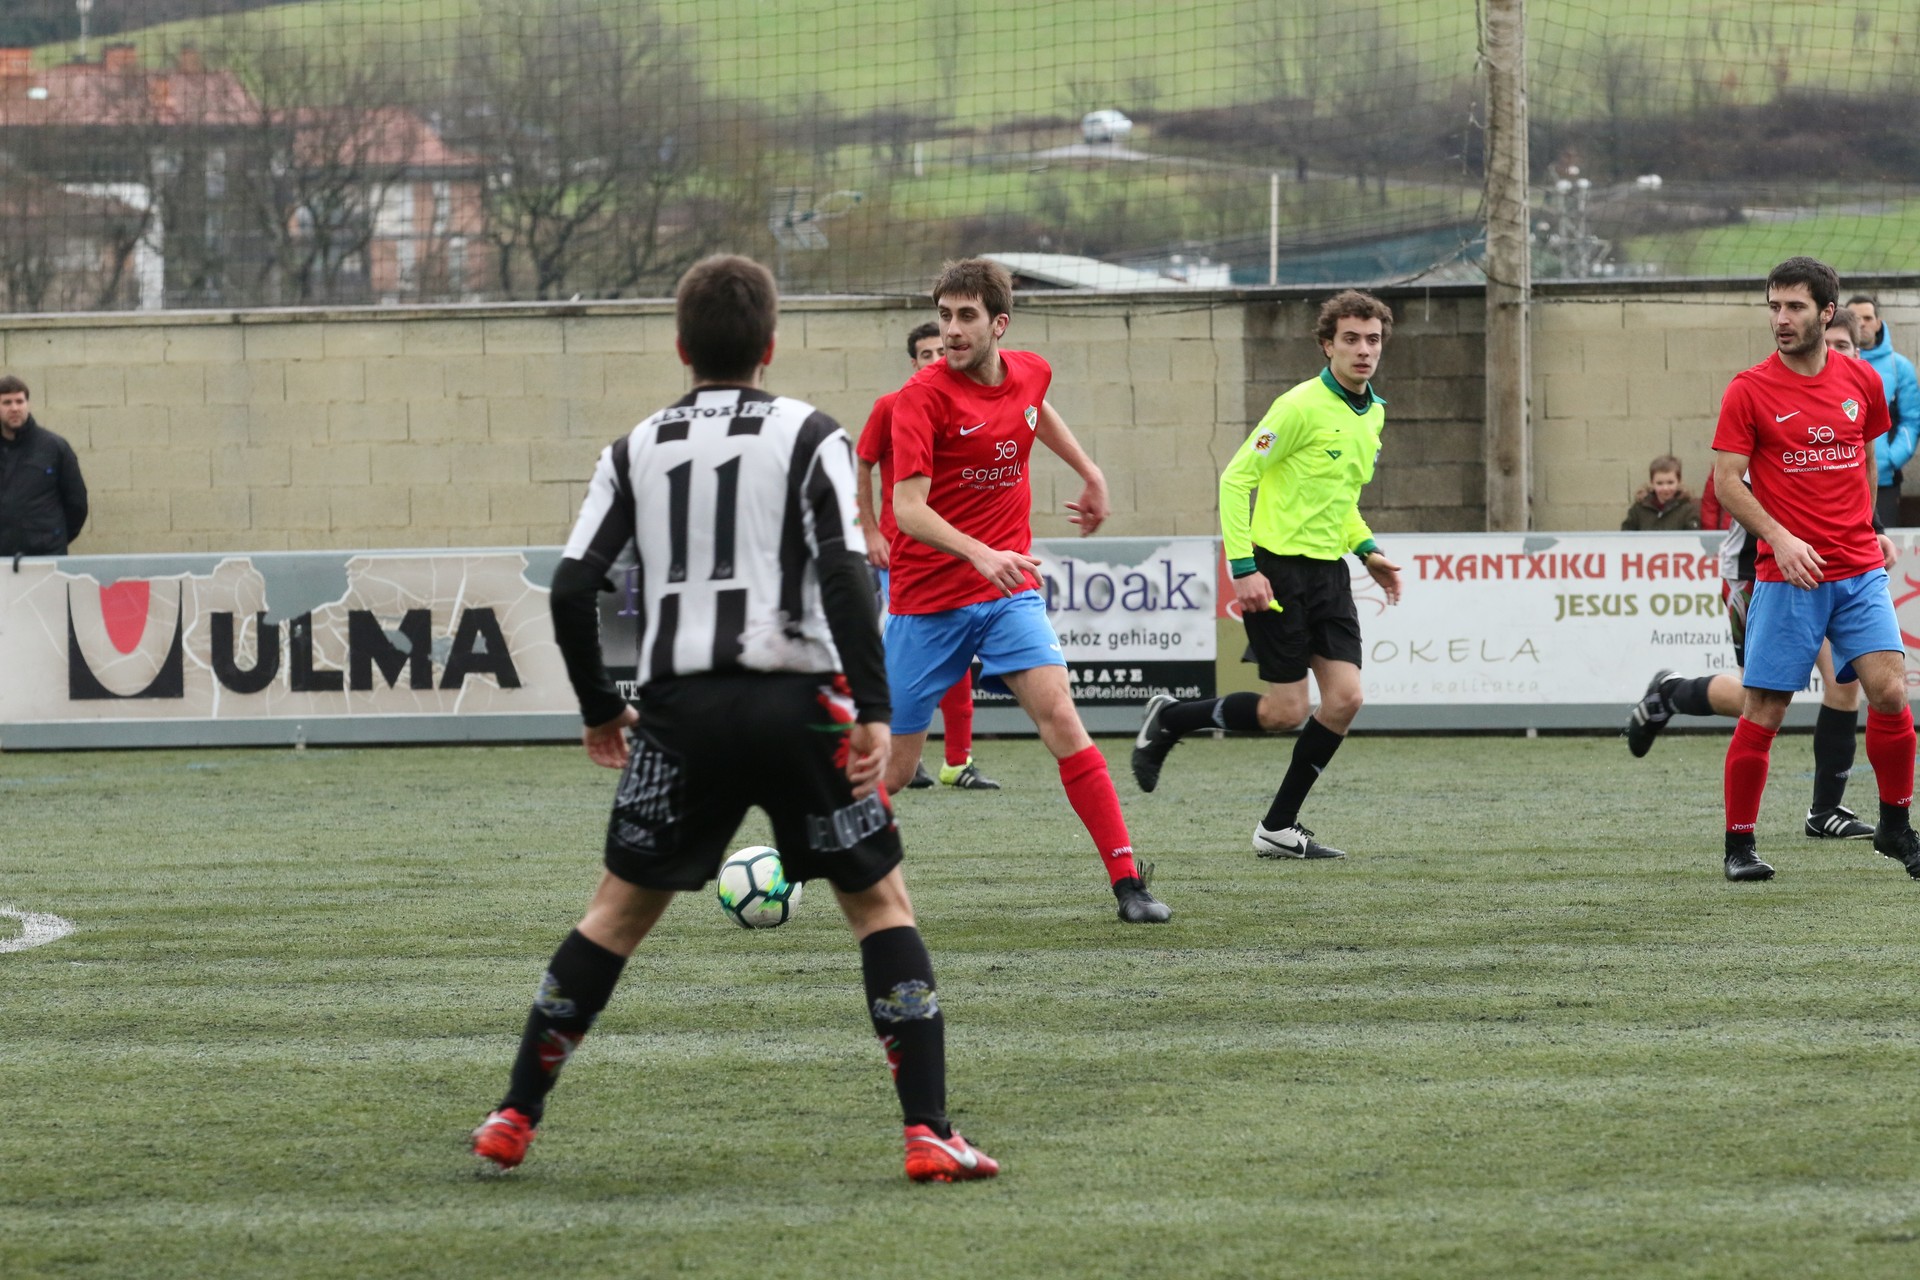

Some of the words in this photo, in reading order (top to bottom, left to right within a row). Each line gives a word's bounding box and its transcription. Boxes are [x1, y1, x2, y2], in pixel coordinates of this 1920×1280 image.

[1808, 426, 1834, 444] 50
[995, 440, 1018, 461] 50
[1782, 443, 1858, 466] egaralur
[666, 455, 742, 583] 11
[1413, 552, 1605, 582] TXANTXIKU
[1622, 552, 1719, 581] HARA
[1555, 594, 1638, 621] JESUS
[1650, 593, 1724, 618] ODRI
[1108, 628, 1182, 650] gehiago
[1650, 629, 1720, 645] Arantzazu
[211, 607, 522, 694] ULMA
[1371, 638, 1540, 663] OKELA
